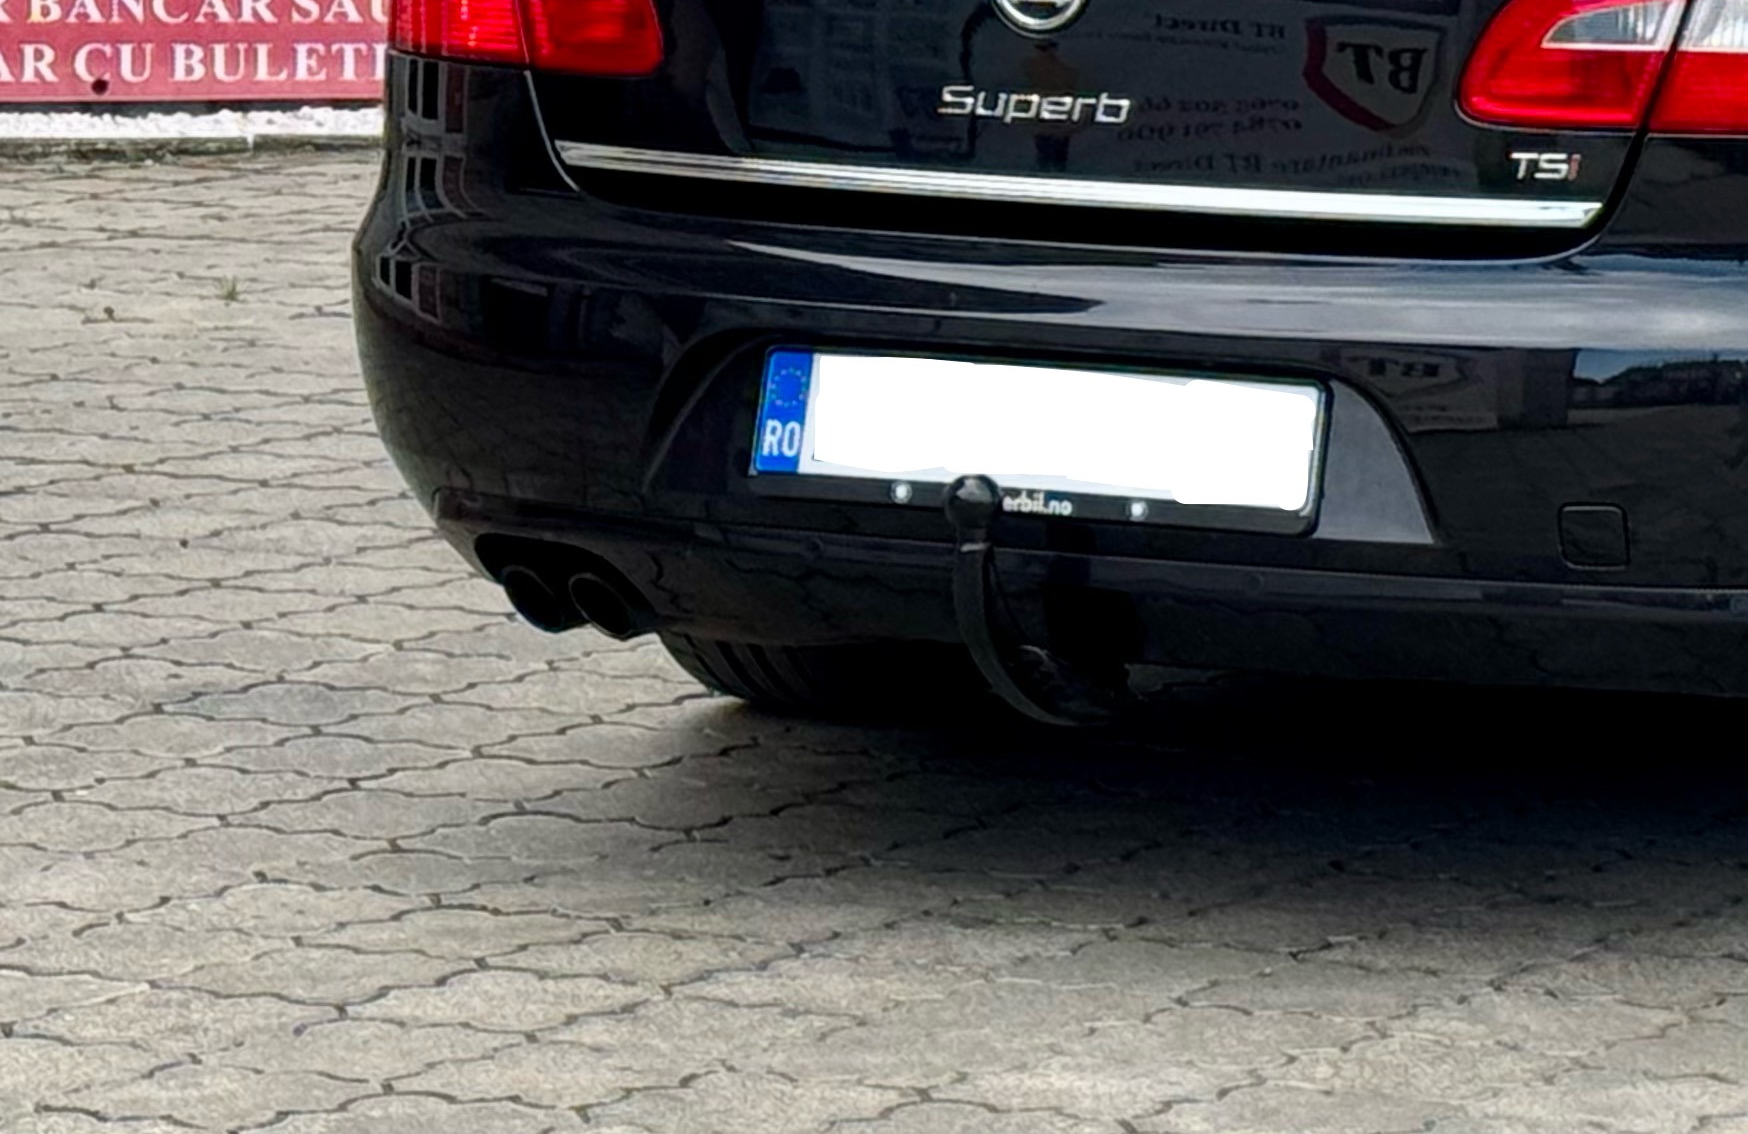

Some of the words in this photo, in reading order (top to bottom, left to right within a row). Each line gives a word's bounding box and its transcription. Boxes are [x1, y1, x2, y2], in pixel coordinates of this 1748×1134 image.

[73, 43, 153, 83] CU
[936, 84, 1131, 124] Superb
[761, 418, 801, 458] RO
